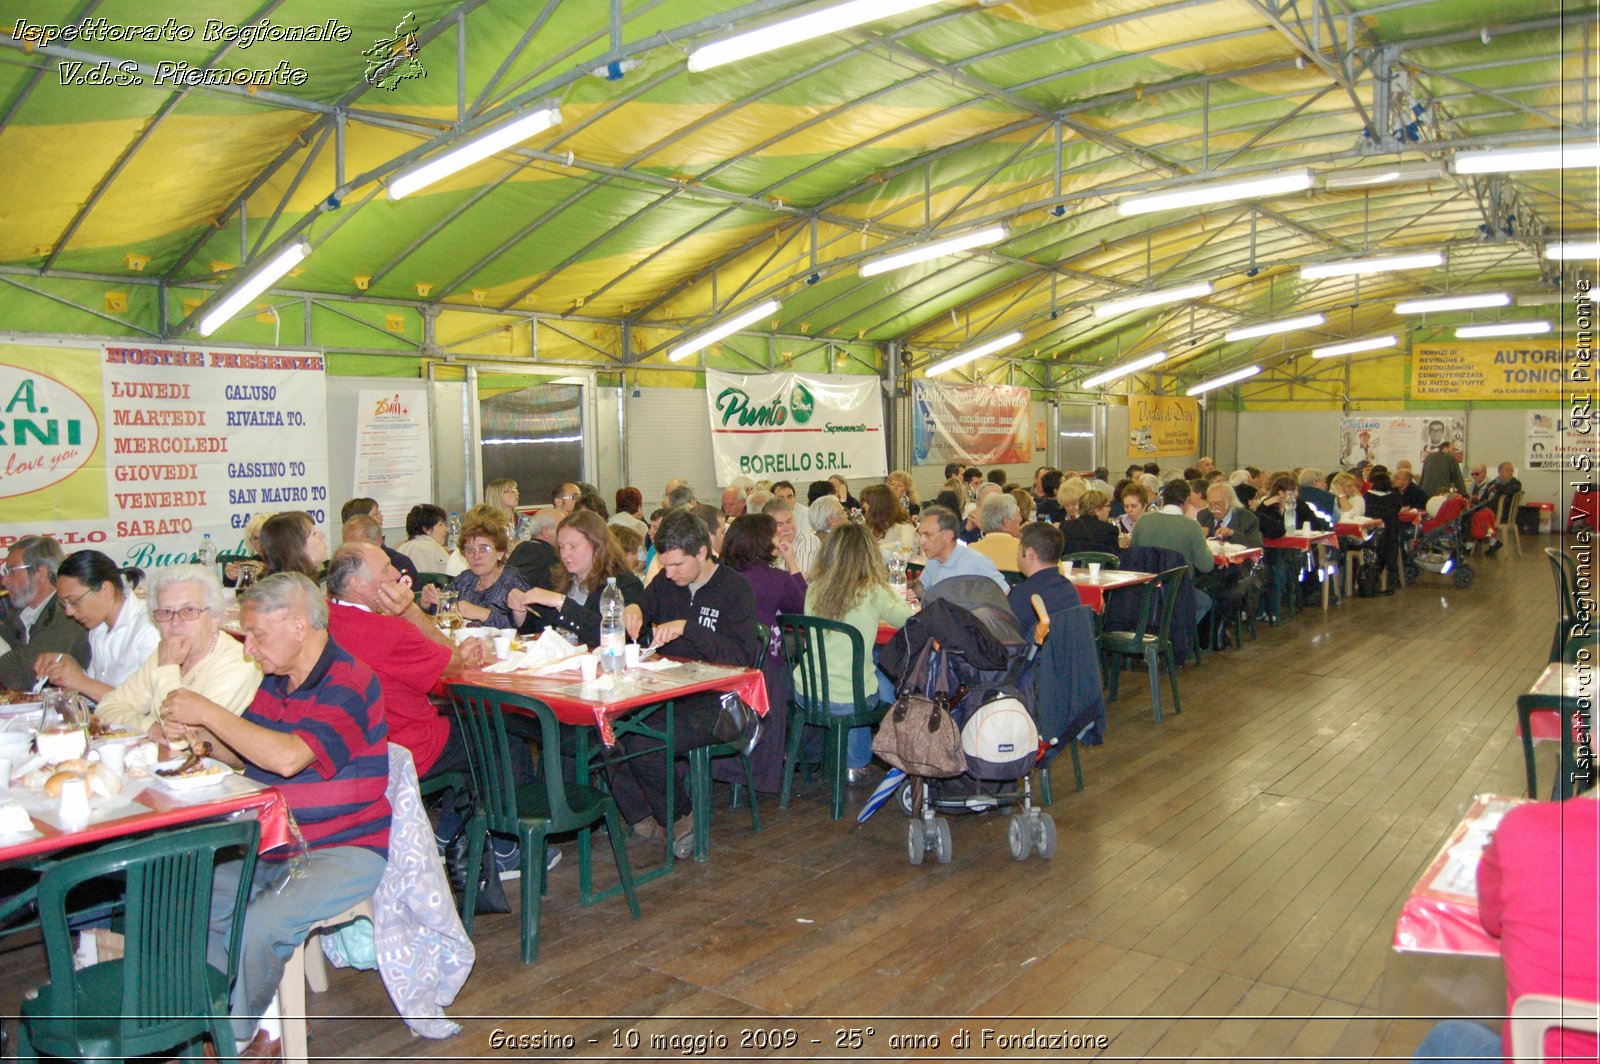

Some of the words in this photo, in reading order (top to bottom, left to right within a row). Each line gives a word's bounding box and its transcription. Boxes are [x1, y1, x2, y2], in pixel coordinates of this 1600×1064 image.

[106, 347, 204, 367] NOSTRE
[209, 352, 324, 370] PRESENZE
[111, 381, 191, 399] LUNEDI
[225, 385, 276, 400] CALUSO
[715, 387, 788, 427] Punto
[113, 409, 206, 426] MARTEDI
[226, 411, 284, 427] RIVALTA
[287, 411, 306, 426] TO.
[114, 437, 228, 454] MERCOLEDI
[5, 453, 44, 476] love
[50, 449, 79, 472] you
[228, 462, 286, 478] GASSINO
[289, 461, 305, 477] TO
[739, 453, 812, 474] BORELLO
[815, 451, 852, 470] S.R.L.
[115, 464, 198, 481] GIOVEDI
[115, 490, 207, 509] VENERDI
[229, 488, 256, 505] SAN
[261, 486, 308, 503] MAURO
[311, 485, 326, 501] TO
[117, 518, 193, 538] SABATO
